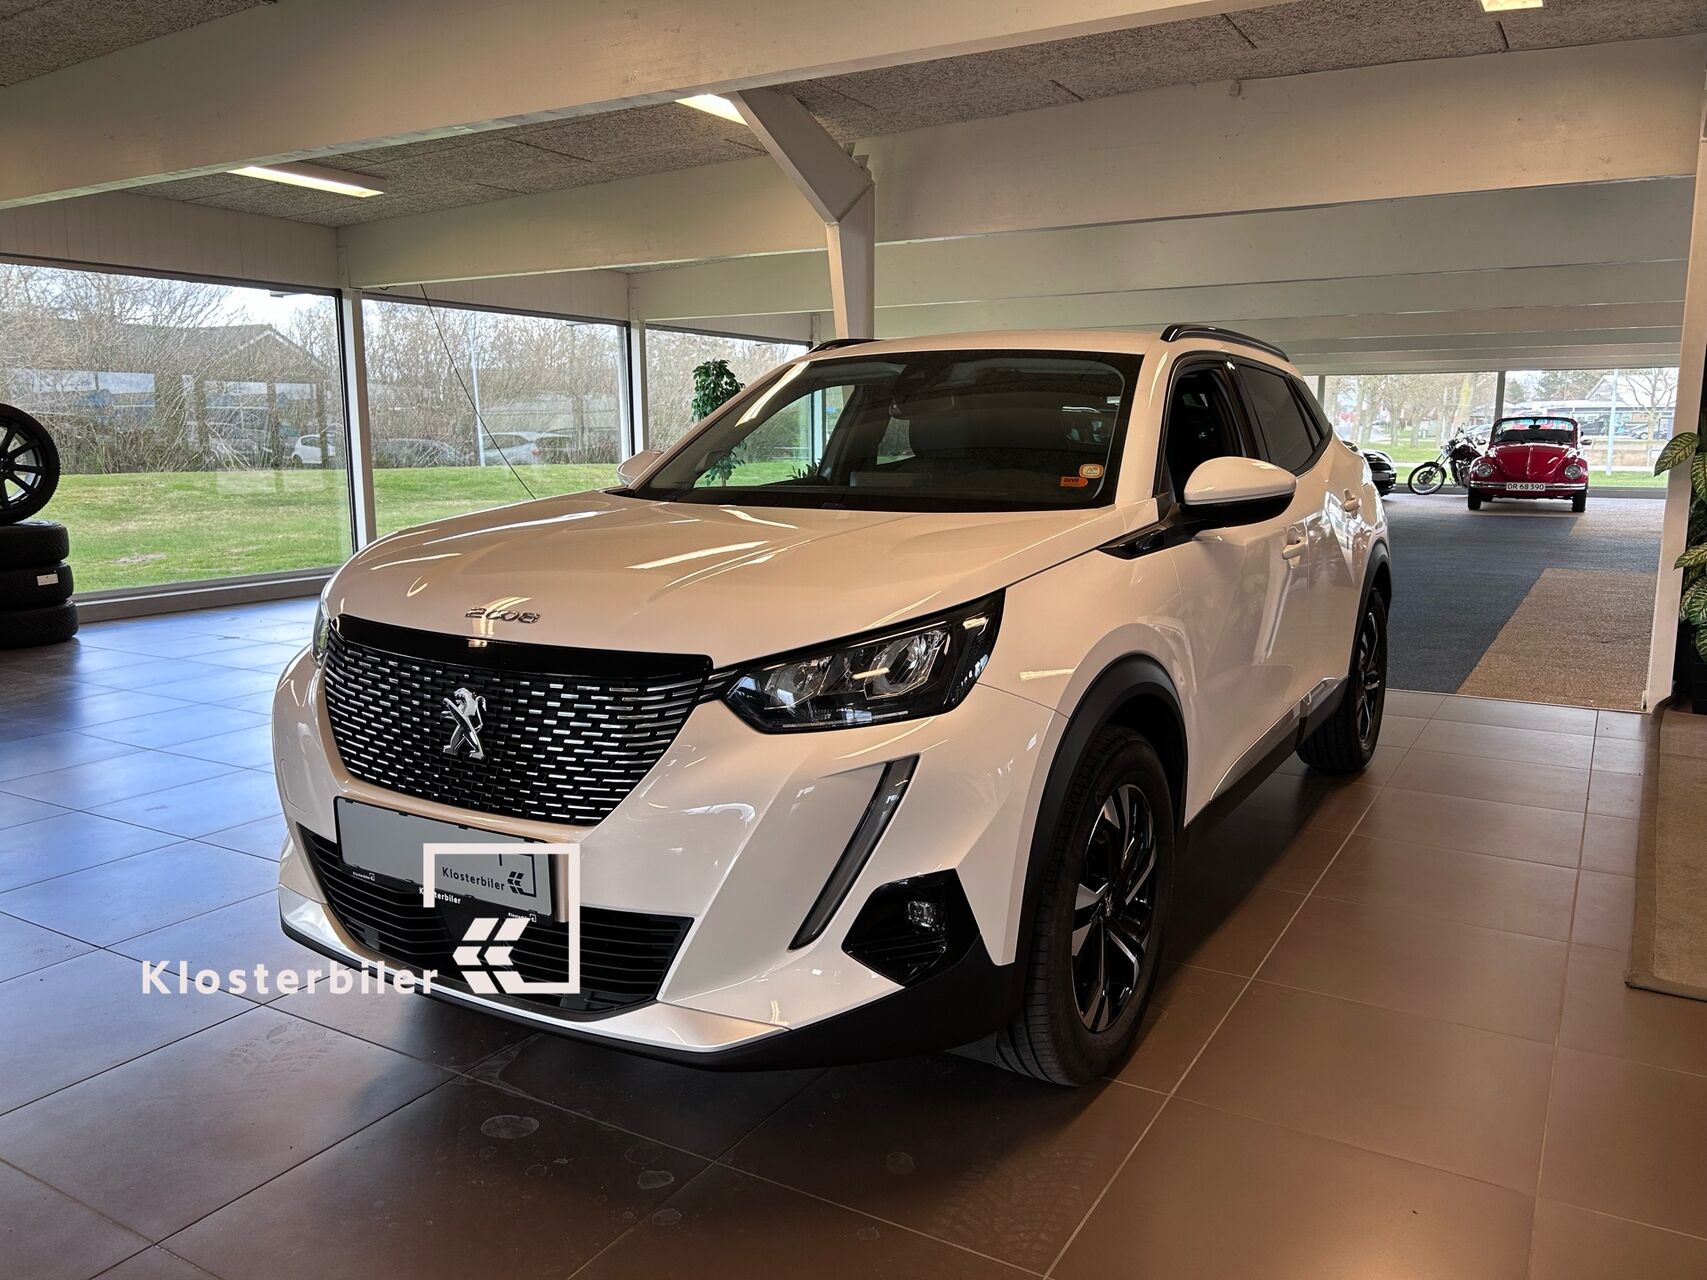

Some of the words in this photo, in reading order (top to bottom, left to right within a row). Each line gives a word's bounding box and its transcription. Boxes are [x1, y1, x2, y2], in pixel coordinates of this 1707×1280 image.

[1530, 483, 1545, 491] 390
[465, 607, 541, 624] 2008
[442, 866, 505, 891] Klosterbiler
[418, 886, 461, 904] Kterbiler
